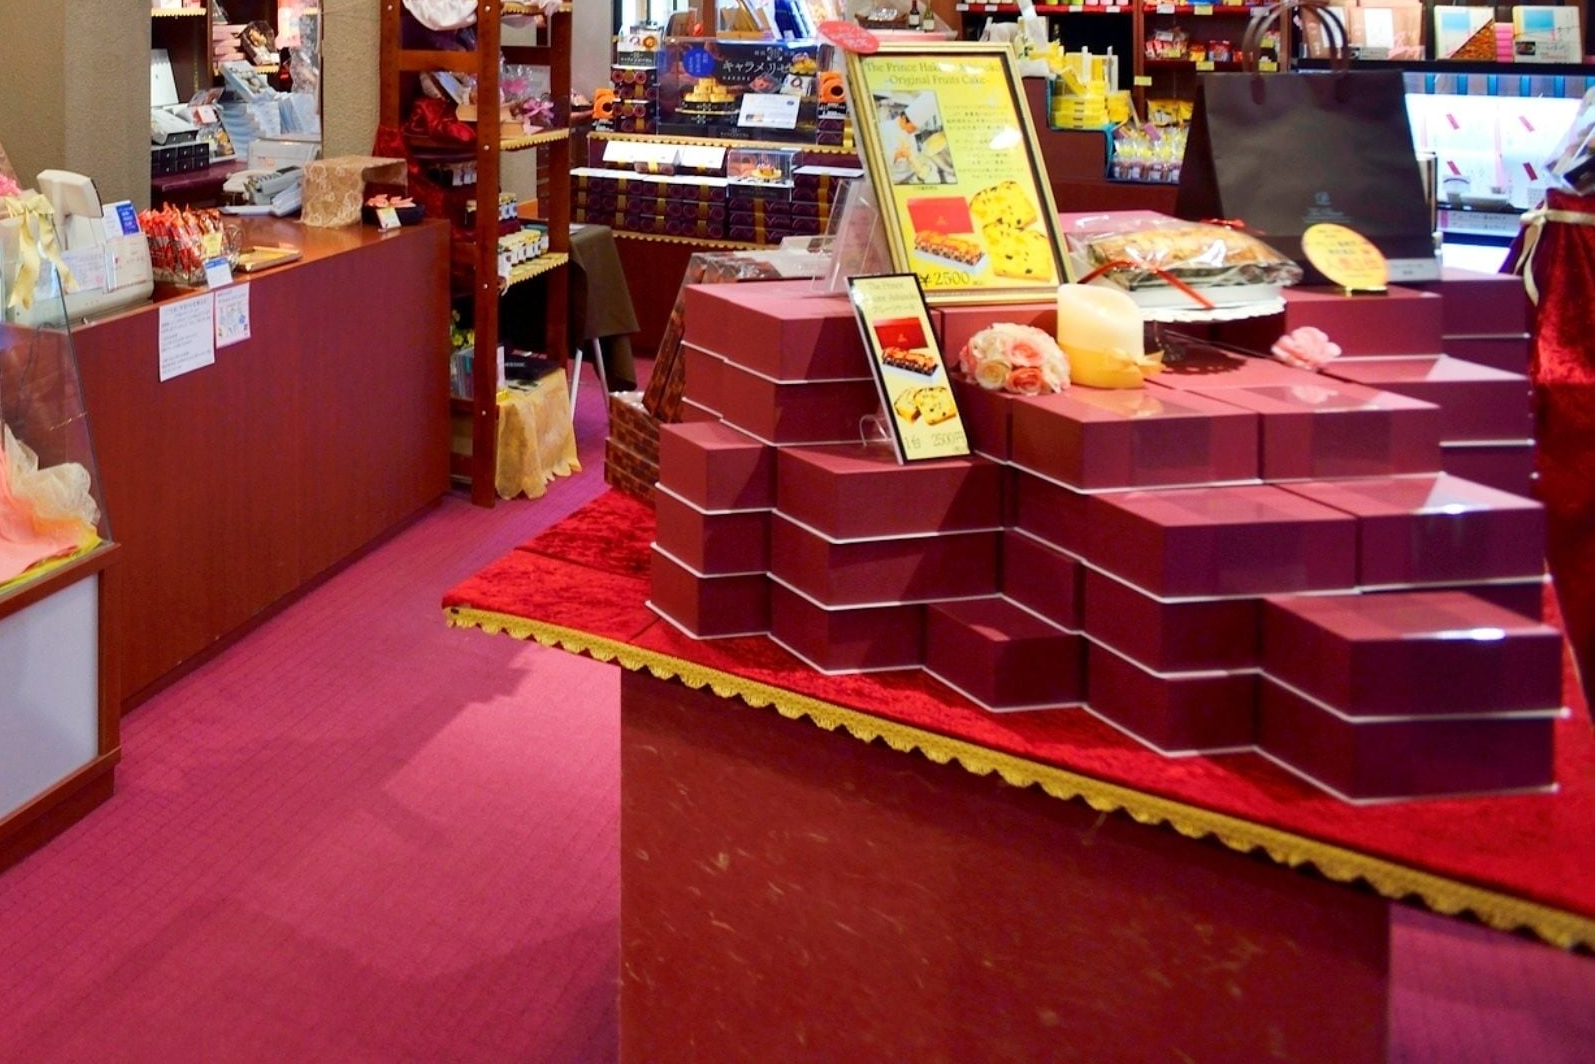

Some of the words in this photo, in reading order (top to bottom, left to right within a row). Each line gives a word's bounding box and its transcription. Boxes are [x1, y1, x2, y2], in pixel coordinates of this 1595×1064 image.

[865, 62, 884, 73] The
[886, 62, 917, 73] Prince
[932, 74, 960, 85] Fruits
